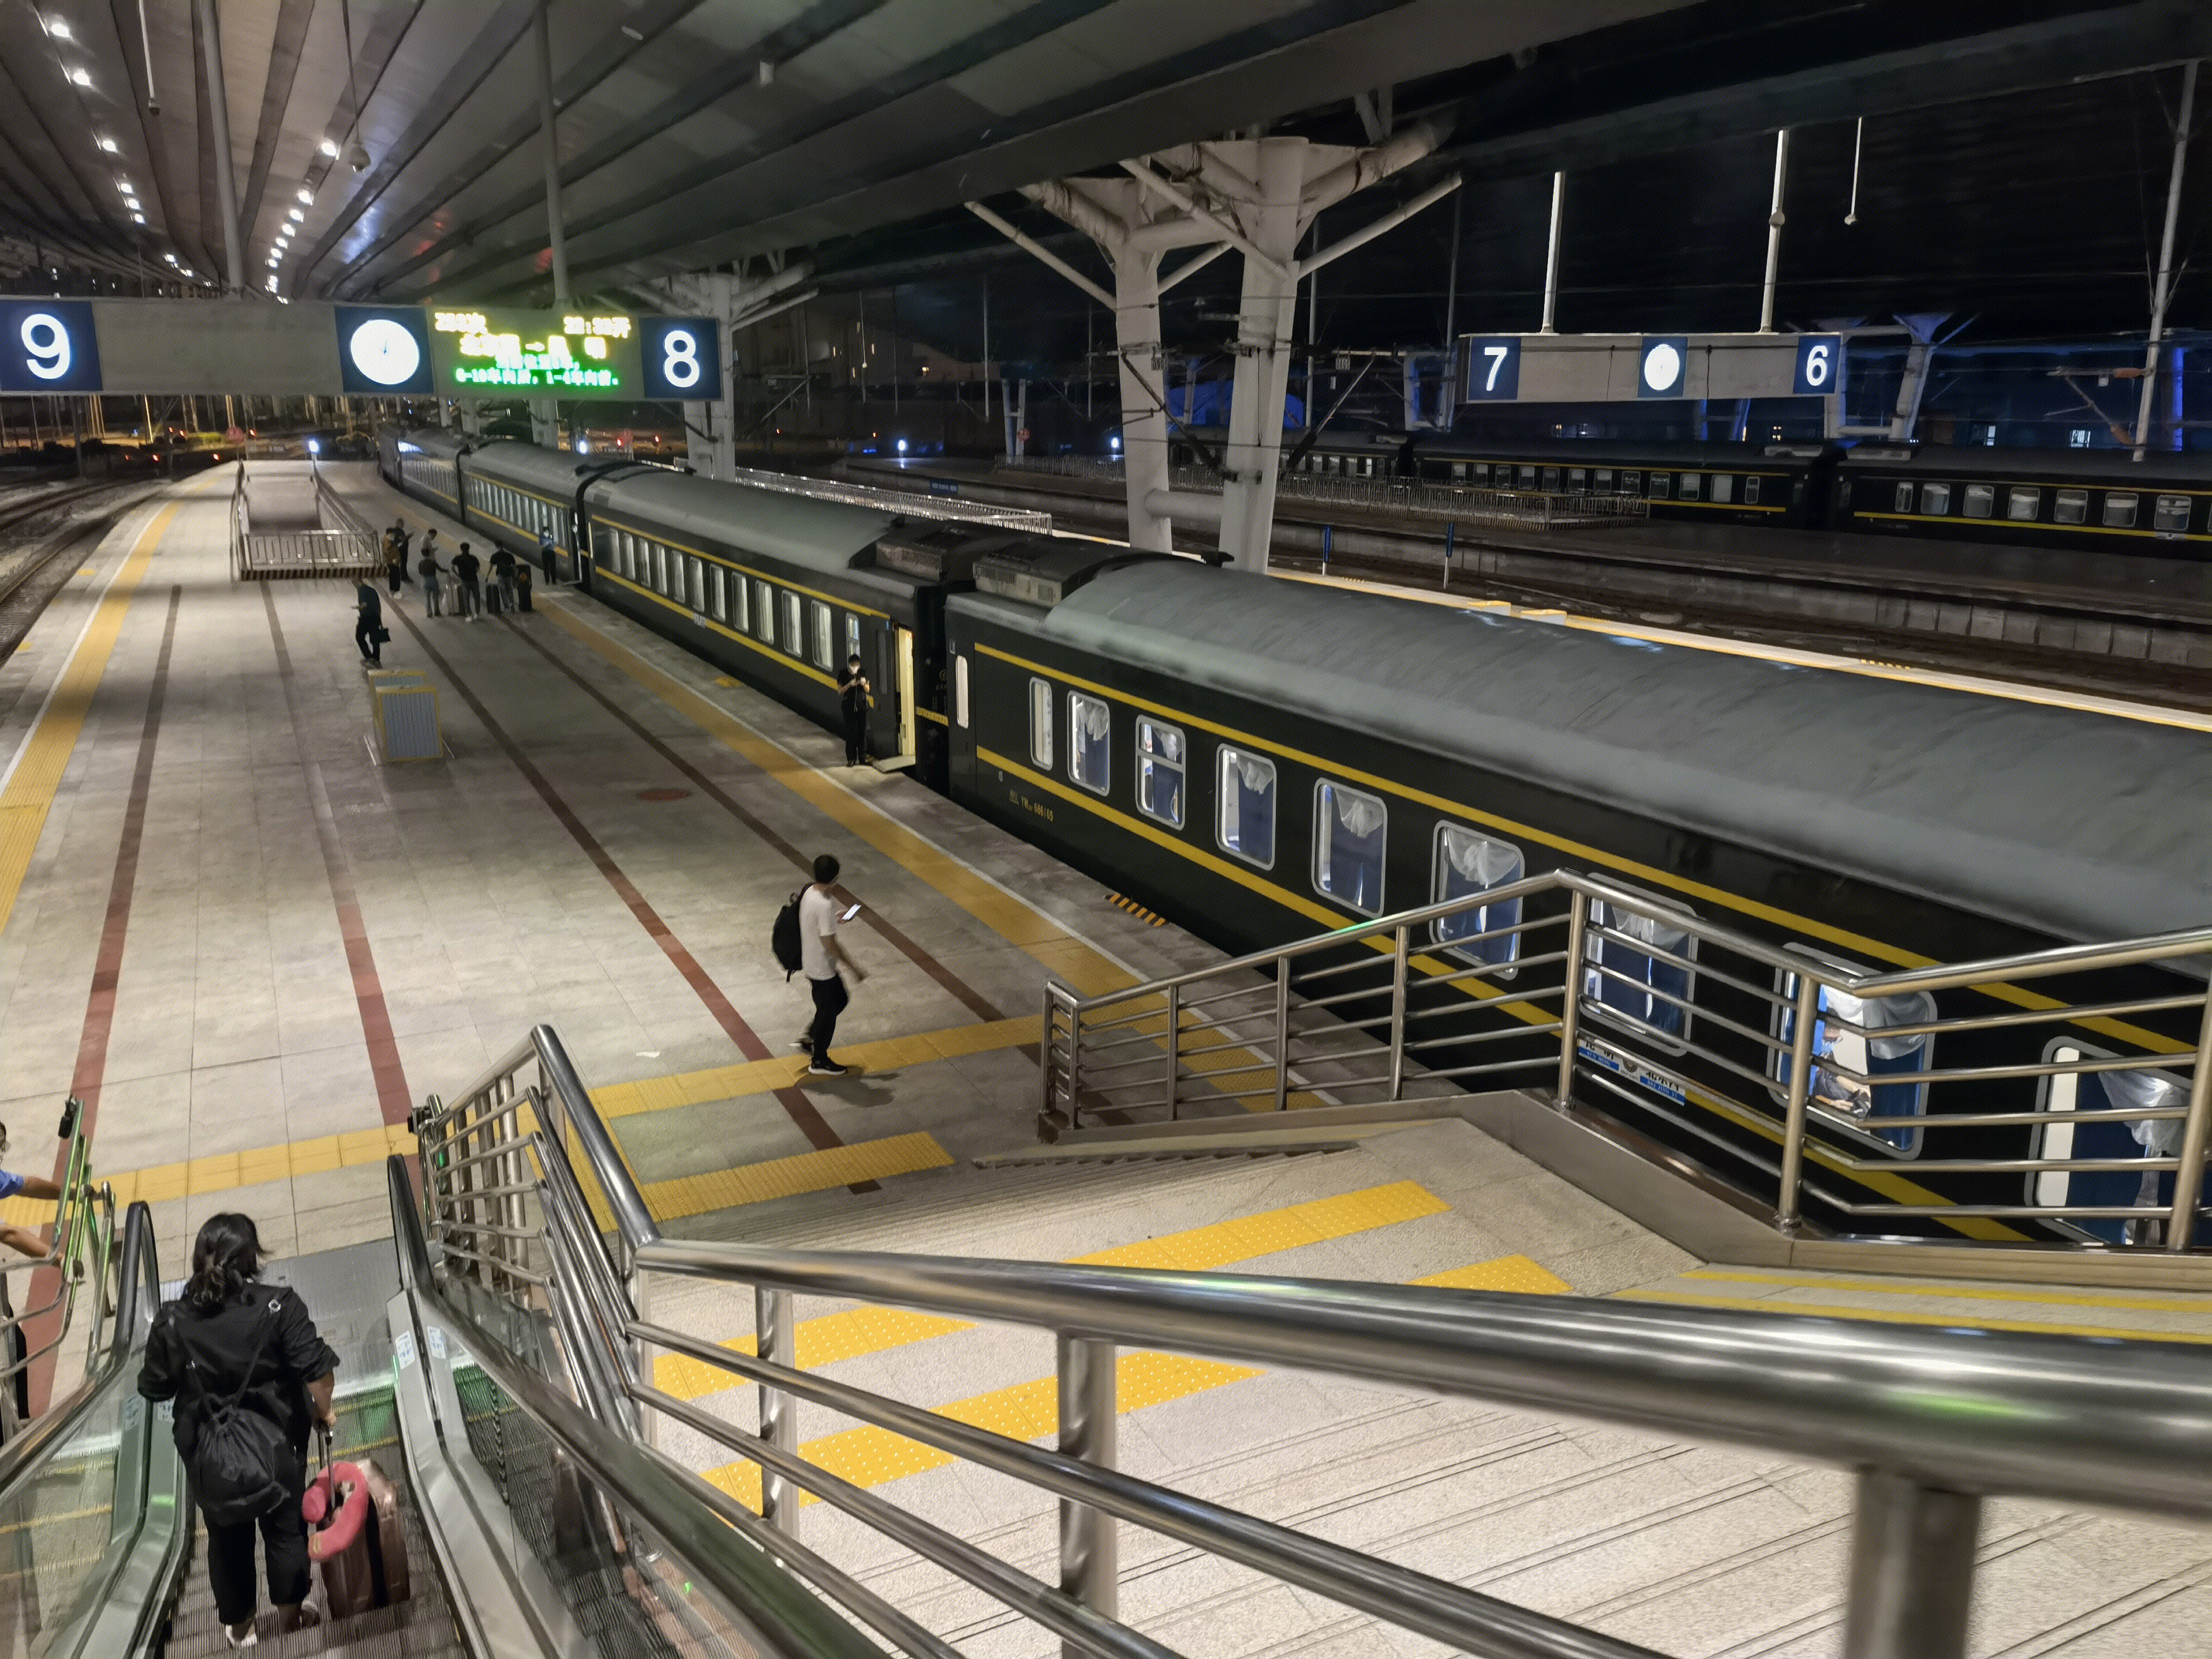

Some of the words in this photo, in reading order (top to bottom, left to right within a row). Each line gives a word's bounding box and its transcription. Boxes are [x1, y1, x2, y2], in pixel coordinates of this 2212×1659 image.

[22, 314, 70, 379] 9
[664, 331, 699, 387] 8
[1485, 347, 1507, 390] 7
[1806, 346, 1827, 386] 6
